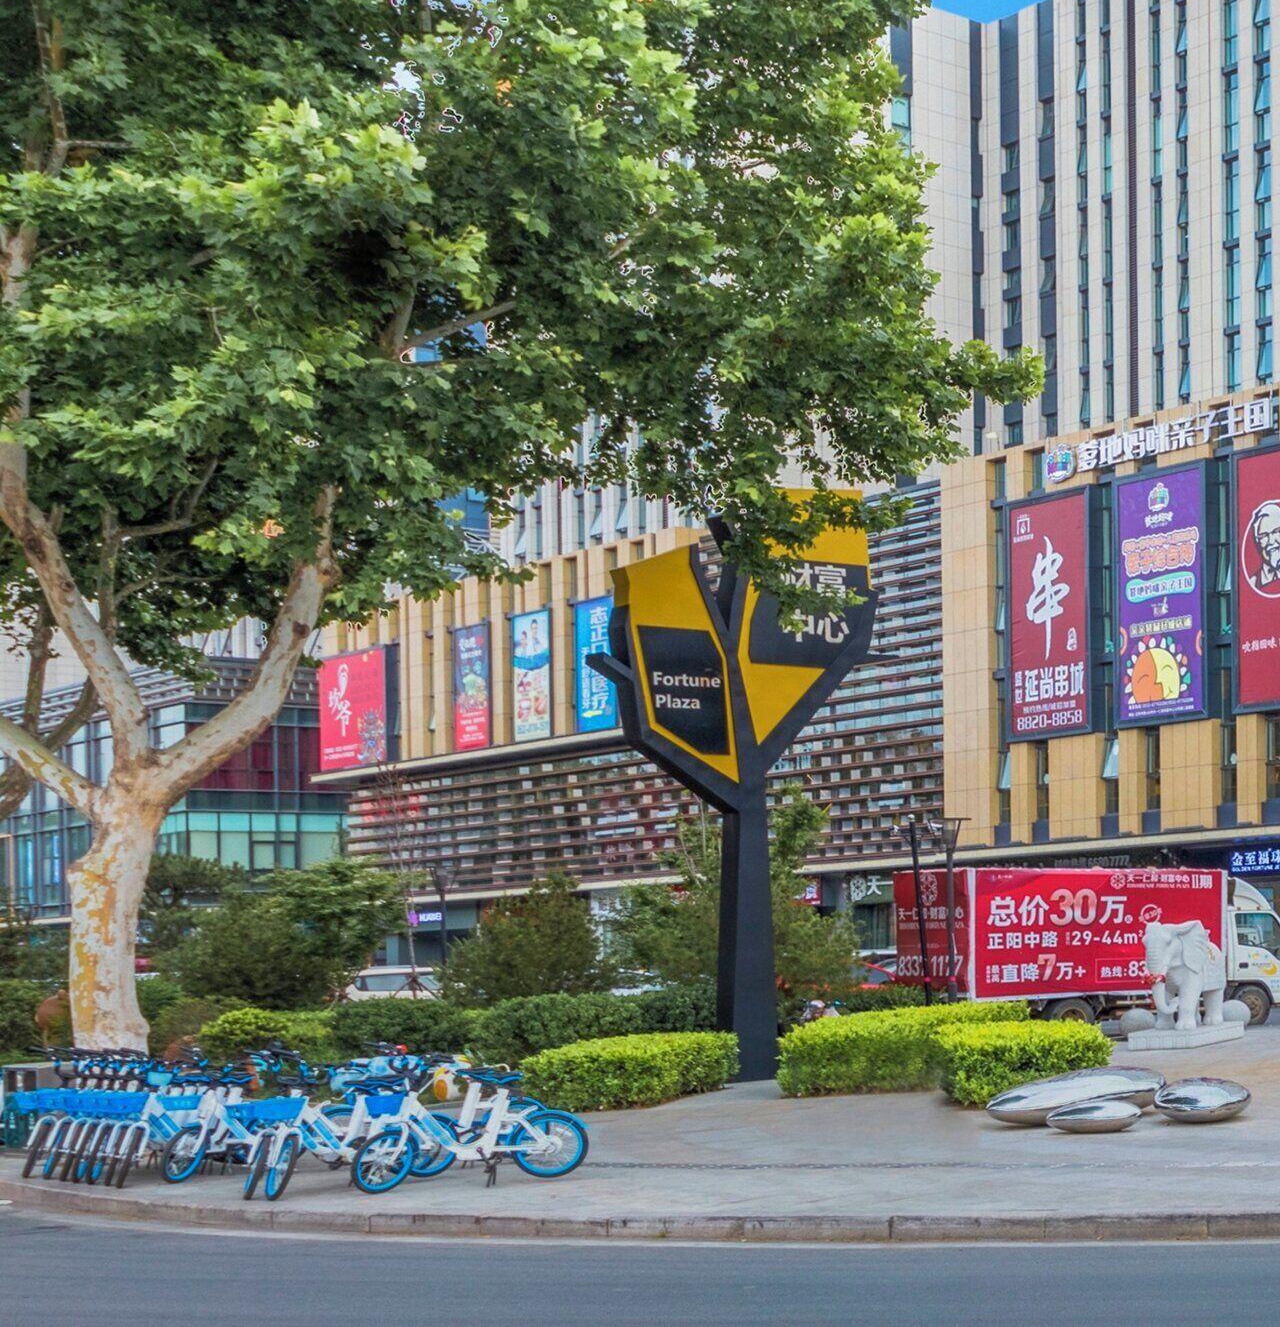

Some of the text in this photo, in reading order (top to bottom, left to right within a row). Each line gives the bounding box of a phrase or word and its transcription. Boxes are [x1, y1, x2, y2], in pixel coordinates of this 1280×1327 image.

[1026, 535, 1071, 661] 串
[783, 608, 850, 644] 中心
[1242, 637, 1277, 653] 吮指回味
[652, 671, 721, 688] Fortune
[1025, 661, 1085, 702] 延尚串城
[655, 694, 701, 710] Plaza
[1017, 709, 1083, 731] 8820-8858
[986, 888, 1128, 927] 总价30万
[986, 931, 1059, 950] 正阳中路
[1001, 953, 1087, 984] 直降7万+
